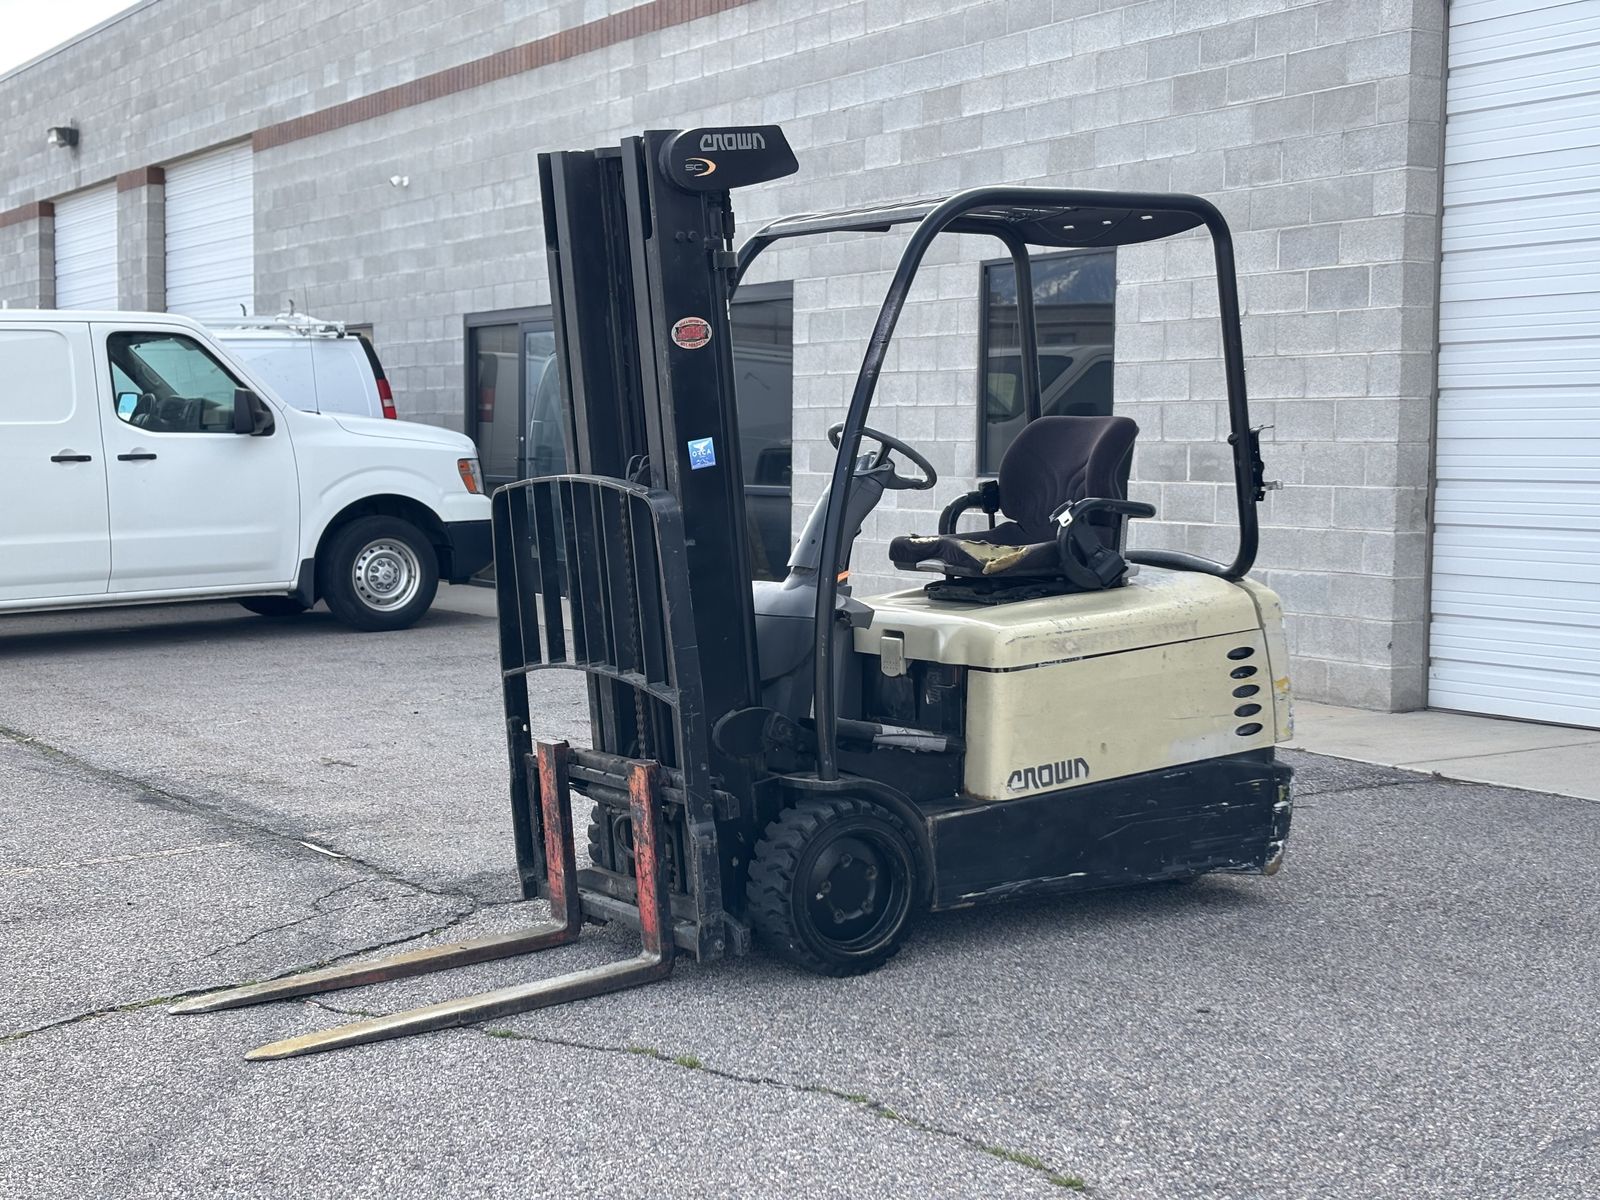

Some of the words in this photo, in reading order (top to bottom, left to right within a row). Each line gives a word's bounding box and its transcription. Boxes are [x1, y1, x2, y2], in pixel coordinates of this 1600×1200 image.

[699, 132, 766, 152] CROWN
[684, 163, 704, 171] SC
[1006, 757, 1090, 791] CROWN
